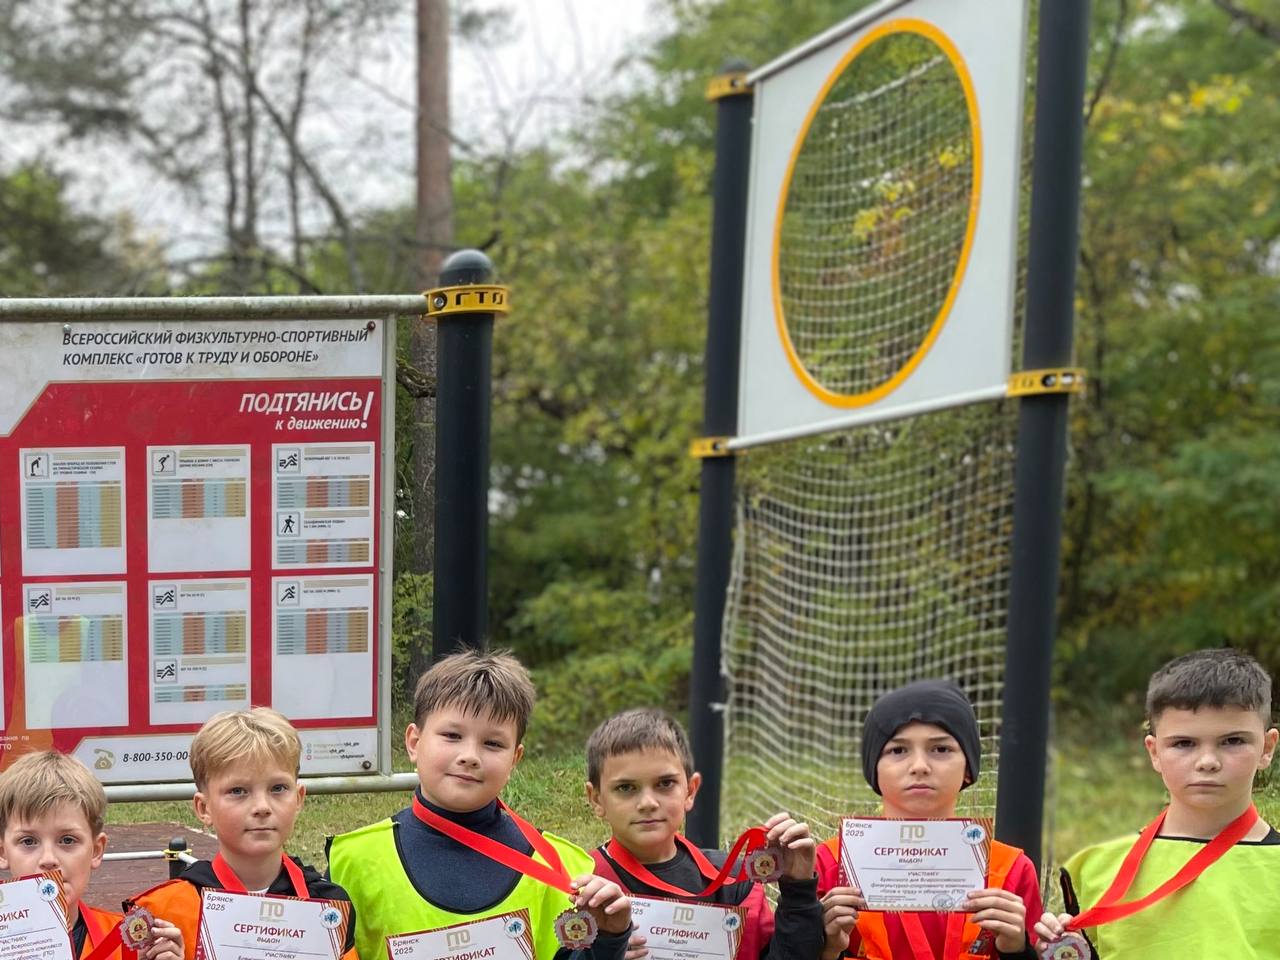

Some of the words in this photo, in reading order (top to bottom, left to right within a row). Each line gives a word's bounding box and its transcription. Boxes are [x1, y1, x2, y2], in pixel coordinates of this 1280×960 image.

[456, 292, 503, 305] ГТО
[62, 331, 172, 345] ВСЕРОССИЙСКИЙ
[176, 328, 369, 344] ФИЗКУЛЬТУРНО-СПОРТИВНЫЙ
[63, 352, 133, 366] КОМПЛЕКС
[135, 351, 182, 365] «ГОТОВ
[185, 352, 195, 364] К
[198, 351, 238, 365] ТРУДУ
[240, 351, 250, 363] И
[253, 350, 319, 363] ОБОРОНЕ»
[275, 419, 283, 430] к
[873, 847, 948, 856] СЕРТИФИКАТ
[205, 893, 233, 903] Брянск
[205, 902, 225, 911] 2025
[233, 922, 306, 938] СЕРТИФИКАТ
[650, 926, 709, 940] СЕРТИФИКАТ
[391, 938, 419, 948] Брянск
[393, 946, 413, 956] 2025
